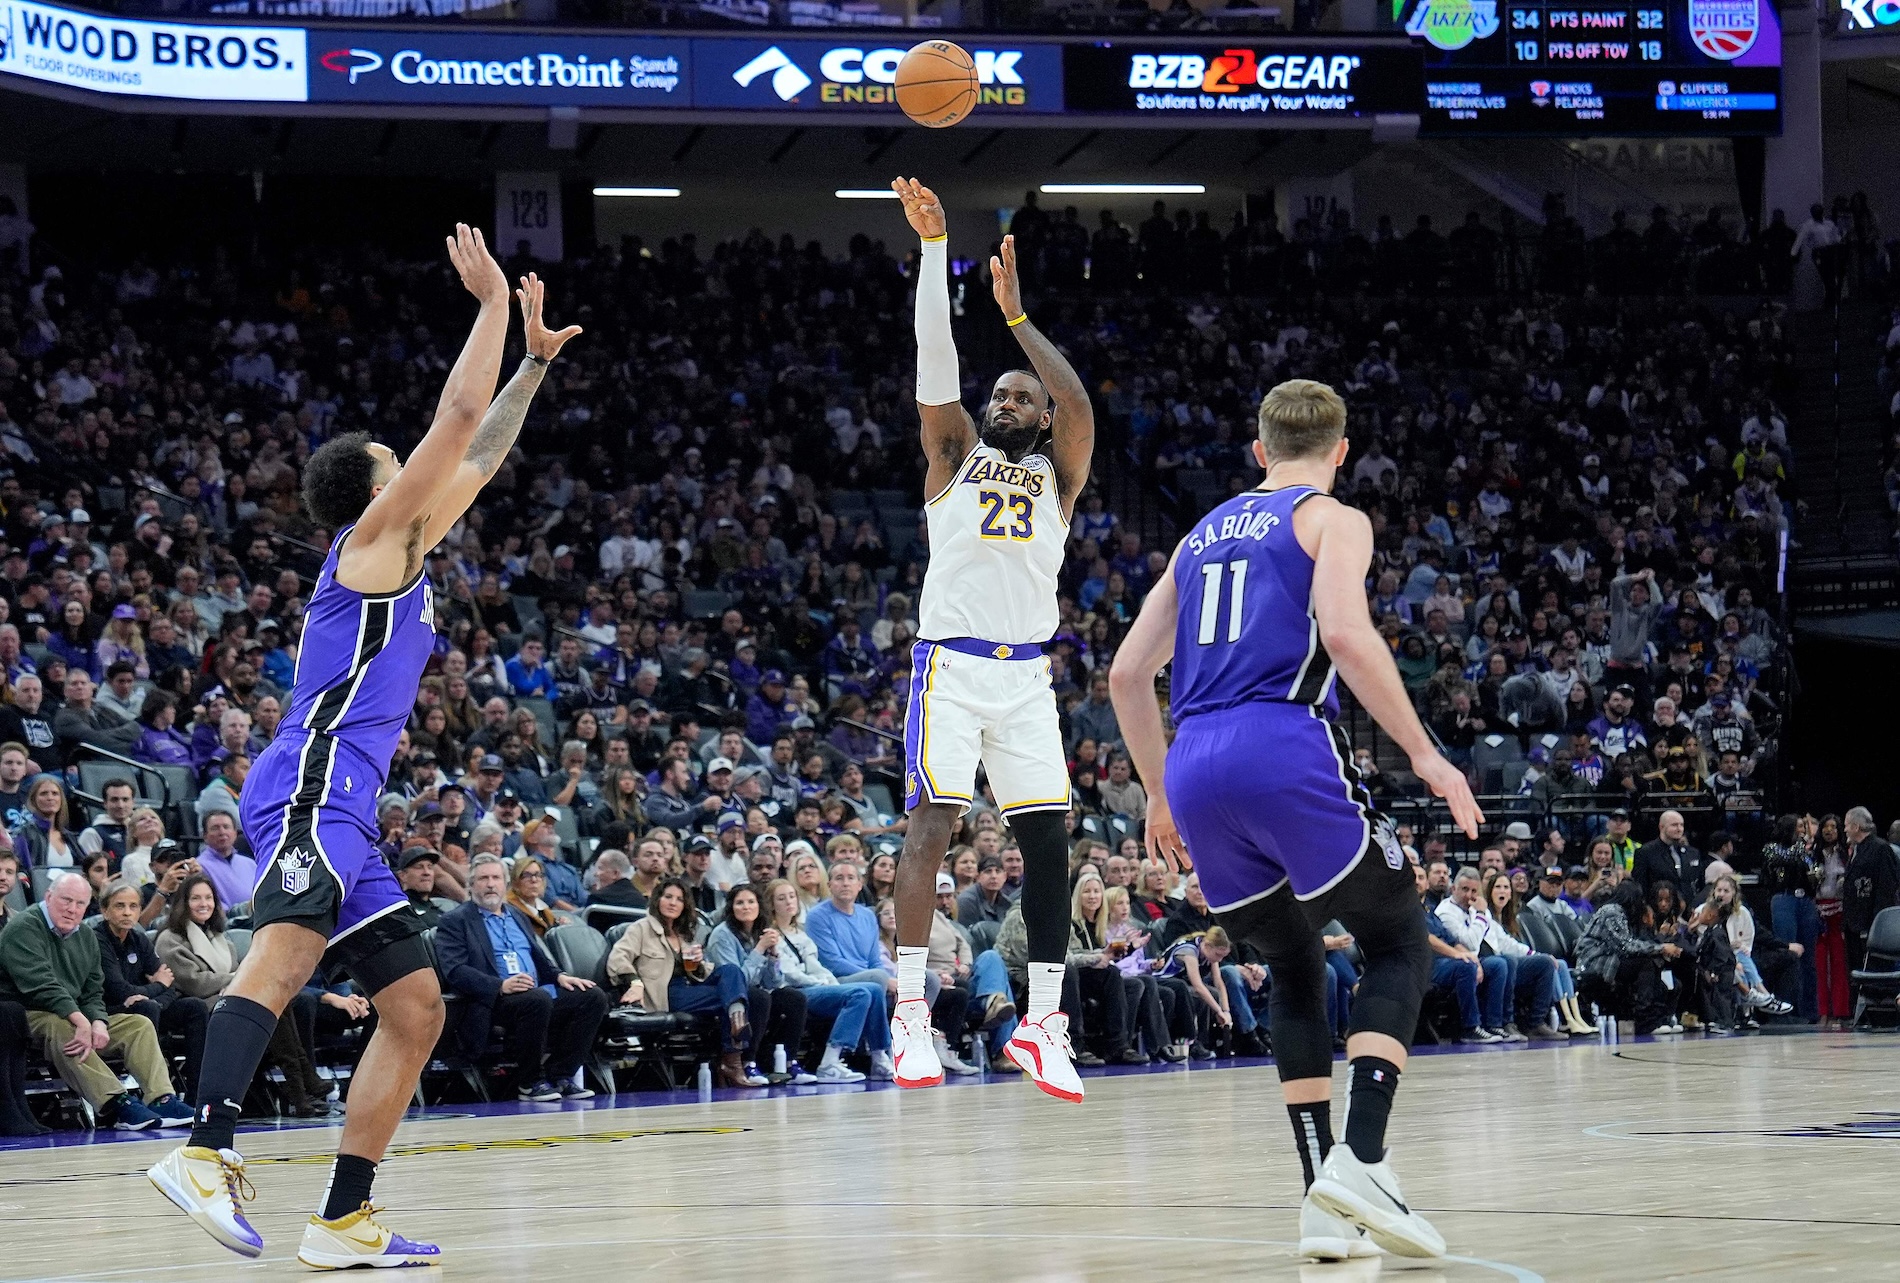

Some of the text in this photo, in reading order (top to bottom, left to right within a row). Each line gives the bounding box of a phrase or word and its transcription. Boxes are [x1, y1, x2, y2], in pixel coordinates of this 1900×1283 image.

[1512, 10, 1663, 29] 34 PTS PAINT 32
[1693, 13, 1755, 27] KINGS
[22, 10, 293, 71] WOOD BROS.
[1515, 41, 1538, 60] 10
[1548, 42, 1574, 59] PTS
[1576, 42, 1601, 59] OFF
[1602, 42, 1629, 59] TOV
[25, 54, 142, 86] FLOOR COVERINGS
[391, 50, 624, 87] Connect Point
[629, 54, 678, 73] Search
[820, 47, 1024, 84] COK
[1129, 55, 1205, 88] BZB
[629, 72, 679, 92] Group
[1554, 82, 1593, 95] KNICKS
[1680, 82, 1729, 95] CLIPPERS
[821, 83, 1026, 105] ENGIING
[1136, 93, 1197, 109] Solutions
[1199, 94, 1215, 109] to
[1217, 93, 1270, 112] Amplify
[1271, 94, 1304, 110] Your
[1554, 96, 1604, 109] PELICANS
[1681, 97, 1738, 108] MAVERICKS
[511, 190, 548, 229] 123
[960, 455, 1046, 497] LAKERS
[979, 489, 1036, 543] 23
[1197, 558, 1249, 646] 11
